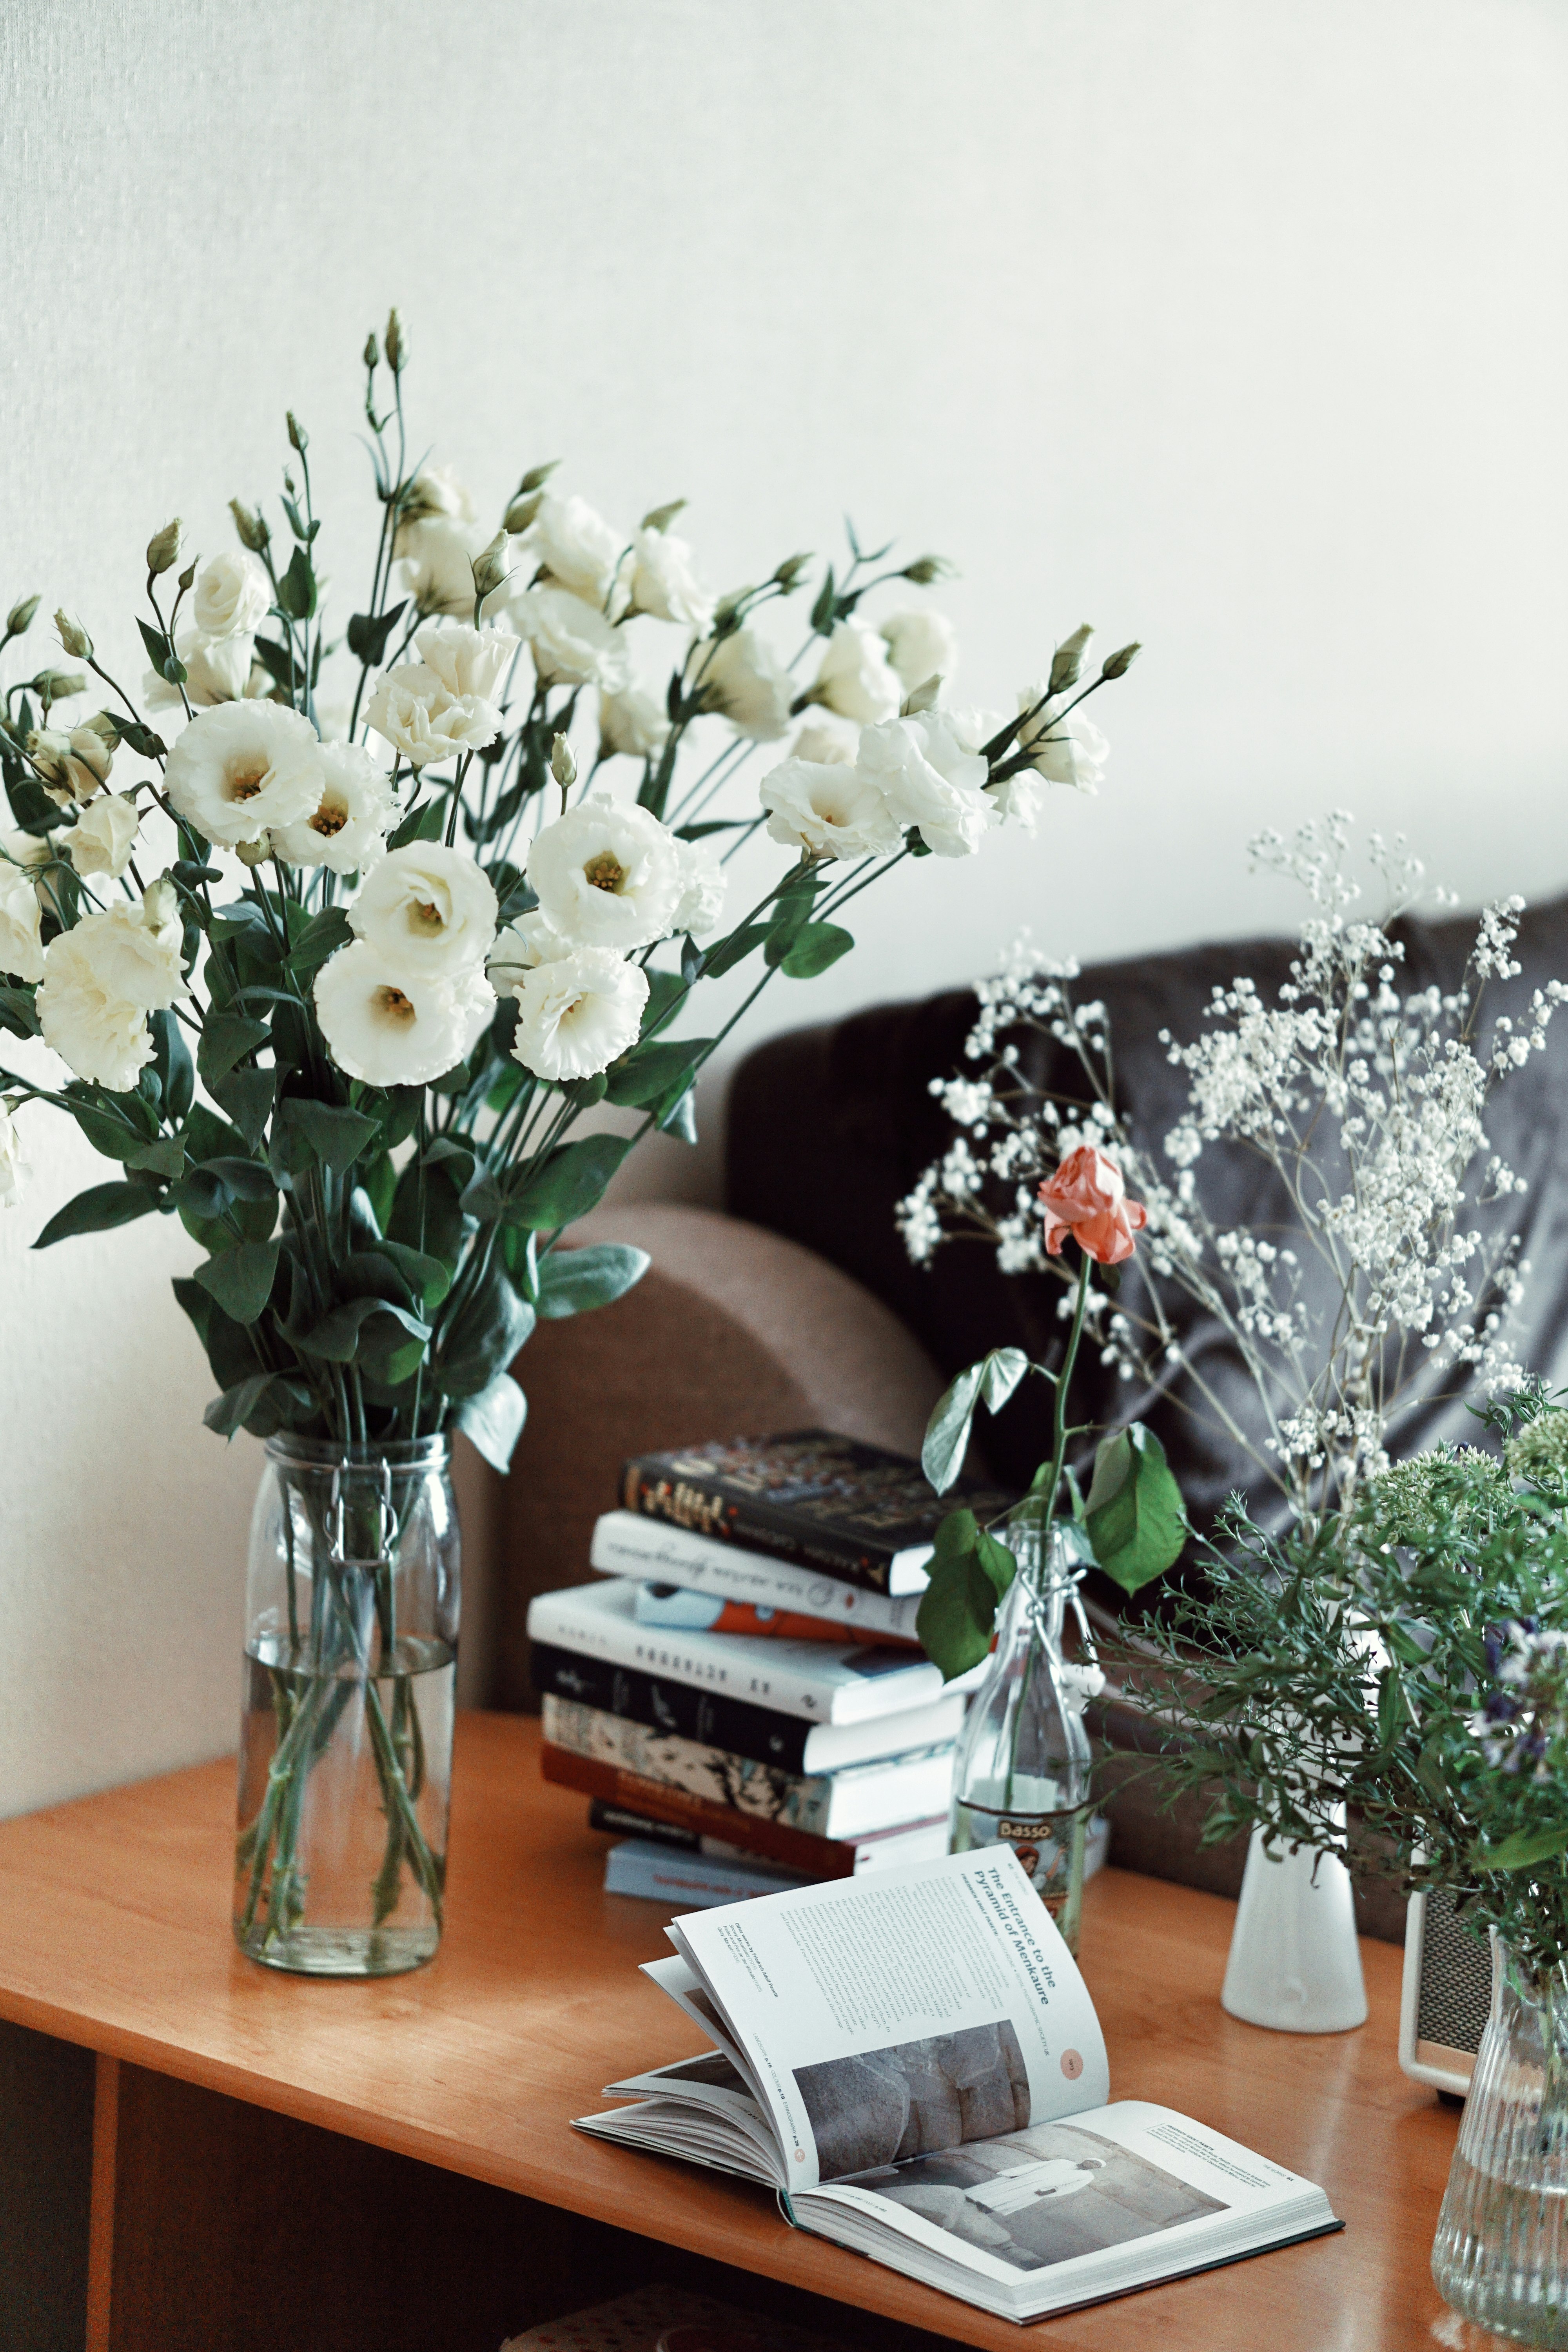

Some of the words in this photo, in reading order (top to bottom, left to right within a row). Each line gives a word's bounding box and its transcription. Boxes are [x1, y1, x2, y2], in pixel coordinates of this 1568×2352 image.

[1001, 1823, 1052, 1837] Basso
[717, 1927, 725, 1937] Quay
[723, 1937, 734, 1951] Market
[729, 1924, 739, 1937] Snowy
[737, 1937, 750, 1958] Mountains
[961, 1873, 978, 1898] FRIEDRICH
[975, 1900, 987, 1915] ADOLF
[974, 1870, 1010, 1920] Pyramid
[1004, 1923, 1019, 1936] of
[1013, 1940, 1049, 2005] Menkaure
[988, 1867, 1004, 1889] The
[1001, 1893, 1035, 1945] Entrance
[1033, 1949, 1044, 1962] to
[1041, 1965, 1056, 1988] the
[723, 1926, 732, 1936] Heinz
[745, 1965, 756, 1980] Hillside
[735, 1922, 744, 1933] Other
[741, 1934, 751, 1947] works
[751, 1953, 764, 1971] Friedrich
[762, 1972, 771, 1983] Adolf
[768, 1983, 779, 1998] Paneth
[779, 1912, 788, 1922] and
[785, 1921, 801, 1947] landmarks.
[799, 1948, 808, 1958] Few
[813, 1973, 827, 1997] enigmatic
[834, 2013, 844, 2029] image.
[786, 1910, 801, 1933] moments
[799, 1933, 808, 1942] and
[804, 1942, 814, 1955] more
[811, 1955, 831, 1986] conventional
[828, 1986, 837, 2000] shots
[837, 2005, 848, 2018] local
[843, 2018, 855, 2035] people
[797, 1916, 808, 1931] family
[806, 1931, 822, 1957] excursions
[824, 1965, 838, 1984] divided
[834, 1983, 847, 2004] between
[844, 2005, 858, 2026] intimate
[807, 1906, 825, 1934] monuments
[826, 1940, 838, 1958] Francis
[836, 1958, 846, 1971] Frith
[842, 1971, 852, 1981] and
[848, 1981, 858, 1996] James
[859, 2002, 869, 2020] Virtue,
[811, 1927, 822, 1942] image
[821, 1947, 837, 1968] personal.
[835, 1969, 844, 1984] Other
[841, 1984, 860, 2015] photographs
[858, 2015, 867, 2030] taken
[813, 1904, 827, 1924] contrast
[833, 1938, 844, 1955] earlier,
[842, 1955, 858, 1981] monolithic
[855, 1982, 869, 2004] portraits
[819, 1903, 838, 1927] positioned
[837, 1933, 854, 1957] alignment
[851, 1958, 860, 1969] with
[862, 1978, 871, 1992] rocks
[869, 1992, 882, 2011] around
[878, 2011, 887, 2025] them.
[829, 1906, 839, 1918] gives
[837, 1918, 848, 1931] equal
[844, 1931, 862, 1959] importance
[862, 1965, 871, 1977] both
[869, 1977, 881, 1999] subjects,
[839, 1908, 858, 1939] southwestern
[856, 1939, 870, 1961] outskirts
[871, 1966, 880, 1982] Cairo,
[882, 1987, 892, 2003] subtly
[889, 2003, 902, 2023] framed.
[846, 1907, 859, 1926] smallest
[864, 1940, 873, 1953] three
[871, 1953, 880, 1966] main
[877, 1966, 893, 1990] pyramids
[893, 1996, 902, 2008] Giza
[847, 1897, 857, 1906] and
[857, 1913, 871, 1935] Egyptian
[872, 1941, 882, 1953] front
[886, 1968, 902, 1993] Menkaure
[899, 1993, 914, 2017] Pyramid,
[855, 1895, 866, 1909] world
[862, 1909, 871, 1920] were
[872, 1926, 882, 1940] black
[879, 1940, 888, 1949] and
[885, 1949, 894, 1965] white.
[893, 1965, 901, 1976] This
[897, 1976, 911, 1996] portrait
[752, 2033, 768, 2057] LANDSCAPE
[764, 2058, 773, 2068] p.16
[770, 2070, 781, 2088] COLOUR
[782, 2101, 797, 2134] ETHNOGRAPHY
